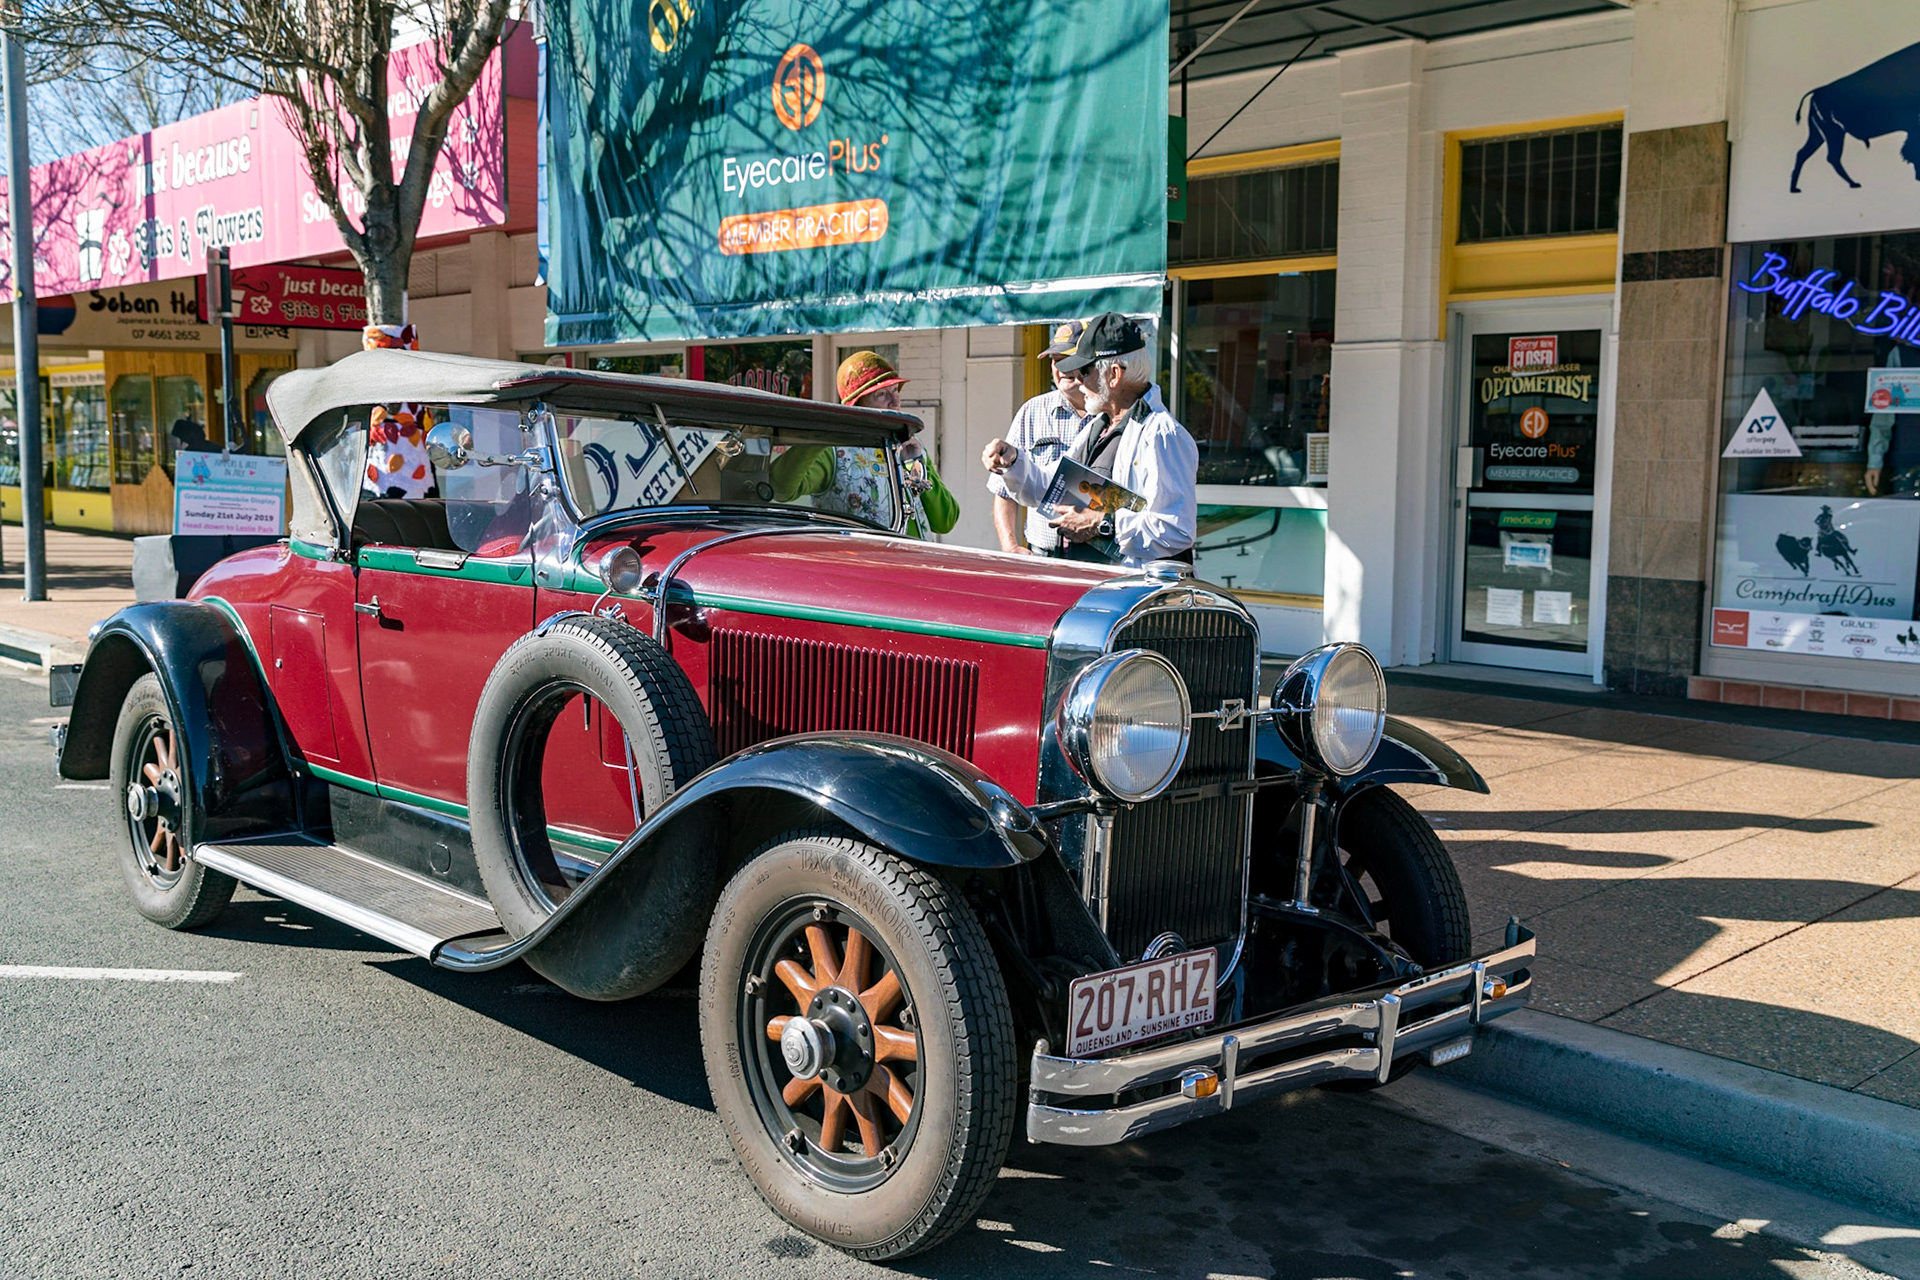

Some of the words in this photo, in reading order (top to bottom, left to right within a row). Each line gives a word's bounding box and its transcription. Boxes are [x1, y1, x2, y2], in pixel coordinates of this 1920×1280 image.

[171, 133, 251, 190] because
[179, 216, 192, 266] &
[195, 203, 264, 258] Flowers
[725, 218, 790, 247] MEMBER
[795, 207, 880, 239] PRACTICE
[320, 278, 367, 298] becau
[1737, 251, 1860, 321] Buffalo
[89, 289, 159, 314] Soban
[280, 301, 319, 320] Gifts
[323, 305, 335, 323] &
[132, 329, 145, 339] 07
[148, 329, 171, 340] 4661
[1513, 350, 1553, 369] CLOSED
[1481, 375, 1592, 404] OPTOMETRIST
[1490, 469, 1528, 478] MEMBER
[1529, 469, 1574, 480] PRACTICE
[182, 521, 202, 529] Head
[185, 510, 215, 519] Sunday
[217, 511, 234, 519] 21st
[236, 512, 252, 522] July
[254, 514, 274, 522] 2019
[1503, 515, 1552, 525] medicare
[801, 850, 912, 949] EXCELSIOR
[1076, 1030, 1132, 1054] QUEENSLAND
[1141, 1015, 1180, 1037] SUNSHINE
